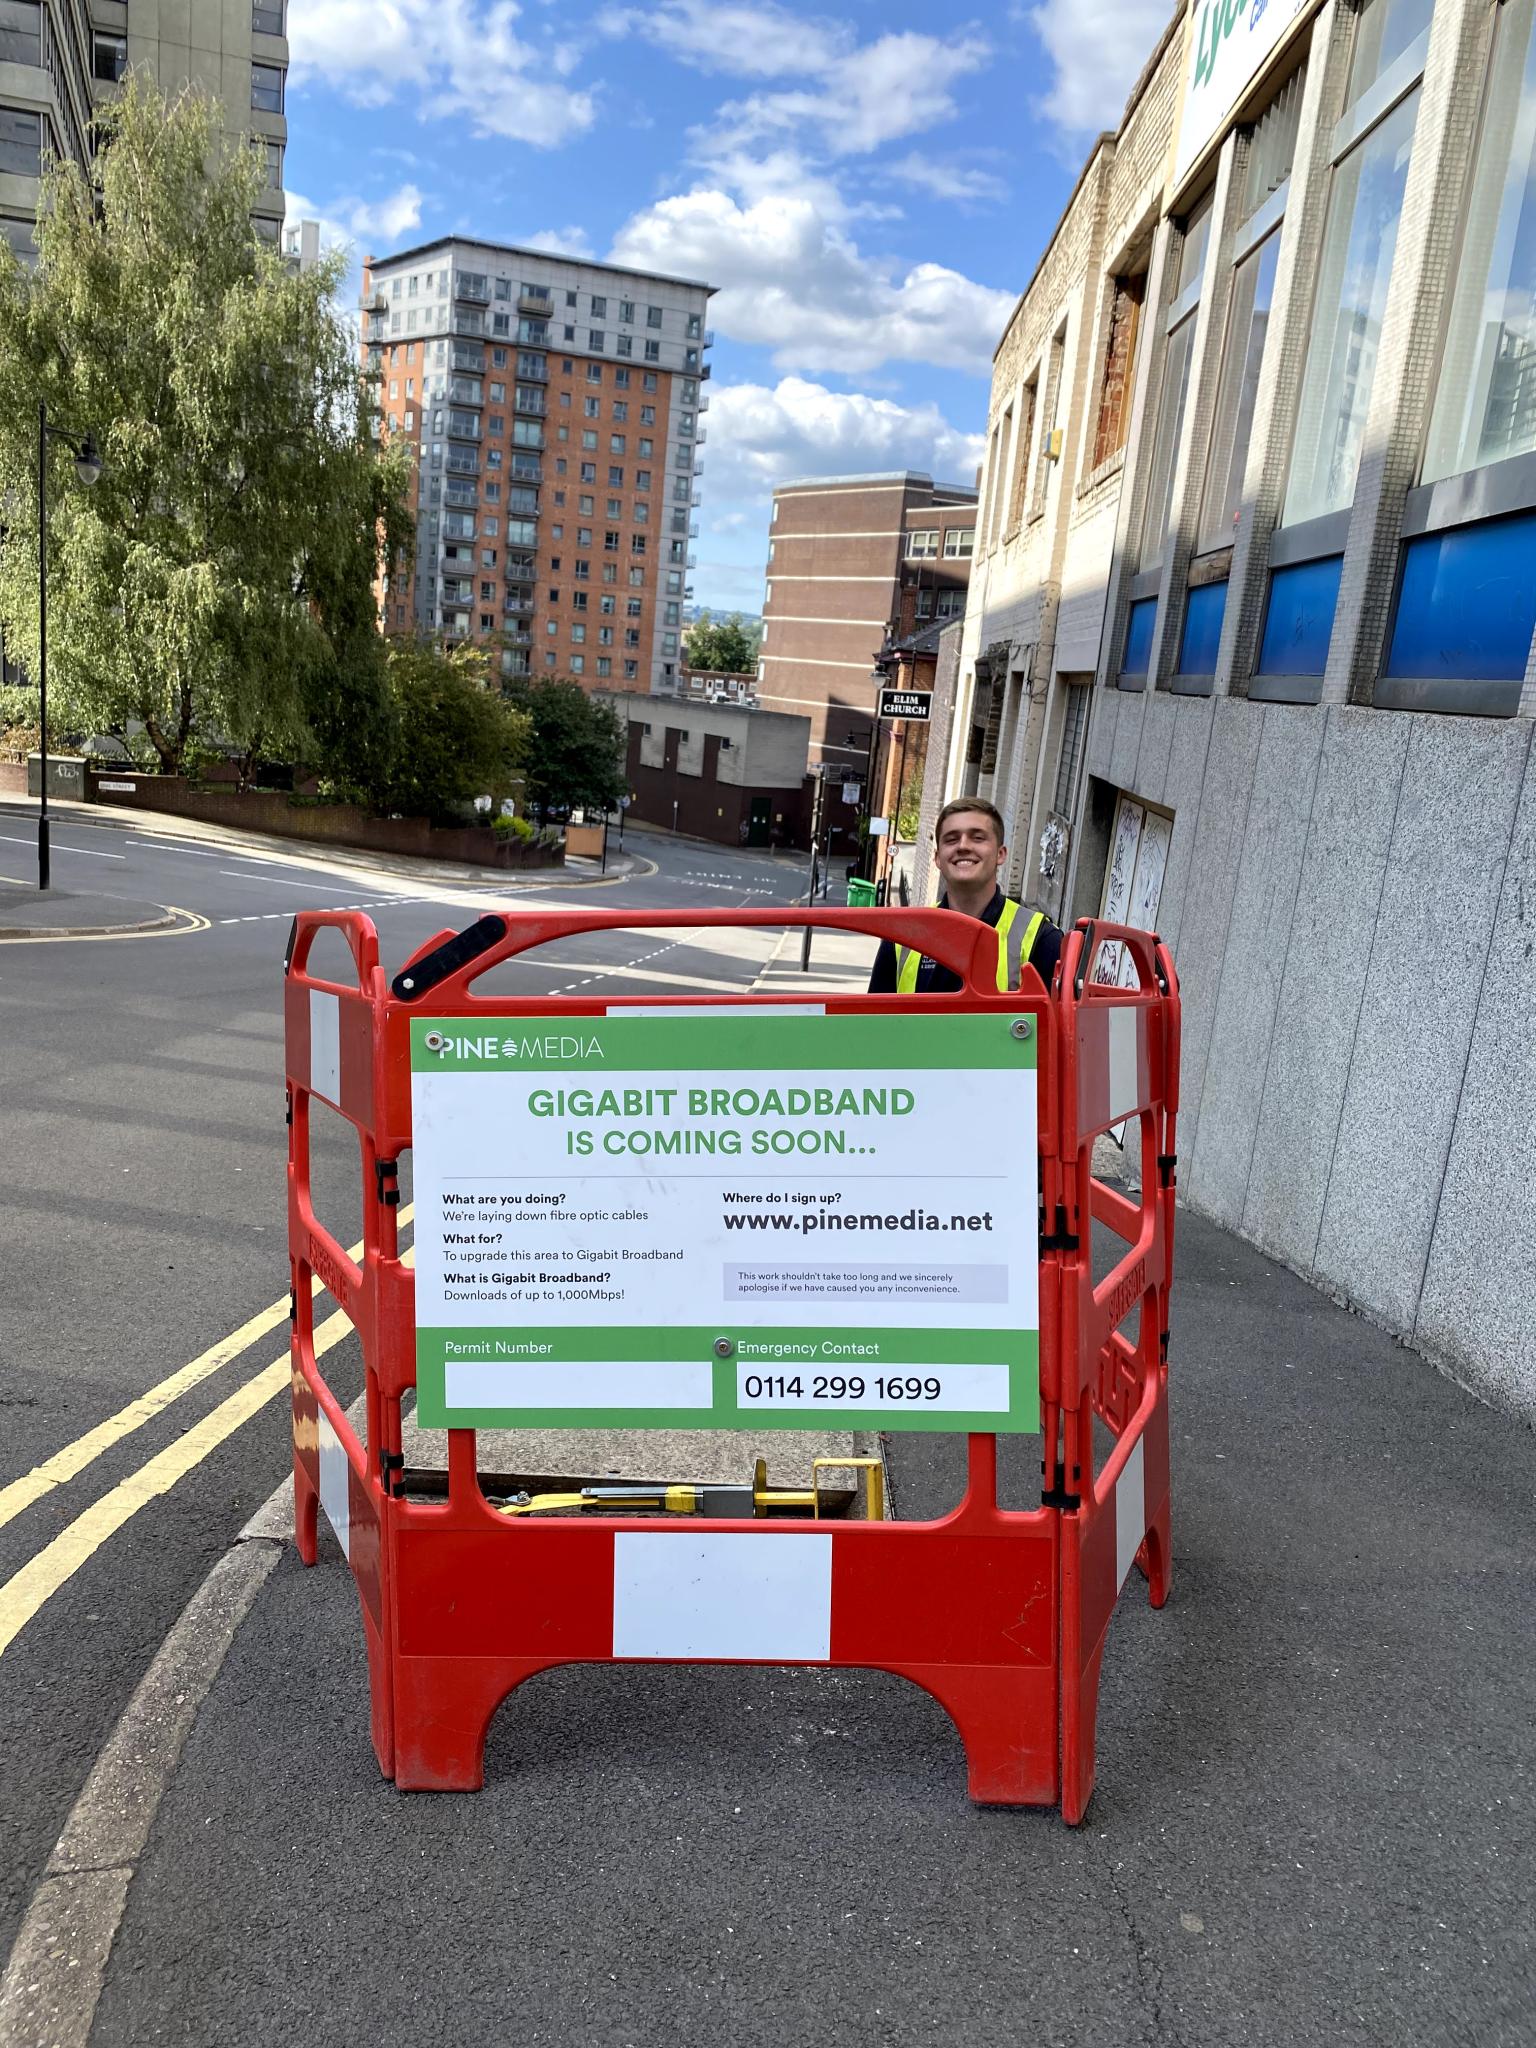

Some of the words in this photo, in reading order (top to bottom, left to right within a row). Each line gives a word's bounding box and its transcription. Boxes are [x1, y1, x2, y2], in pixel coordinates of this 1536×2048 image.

[893, 694, 919, 705] ELIM
[883, 703, 927, 715] CHURCH
[439, 1037, 498, 1059] PINE
[520, 1036, 604, 1058] MEDIA
[528, 1089, 677, 1117] GIGABIT
[689, 1088, 915, 1116] BROADBAND
[567, 1131, 594, 1155] IS
[603, 1130, 741, 1155] COMING
[751, 1130, 876, 1154] SOON...
[441, 1193, 476, 1205] What
[477, 1196, 498, 1205] are
[499, 1195, 523, 1207] you
[524, 1192, 567, 1207] doing?
[722, 1192, 764, 1204] Where
[765, 1192, 782, 1204] do
[791, 1191, 817, 1206] sign
[819, 1192, 842, 1206] up?
[442, 1210, 476, 1222] We're
[477, 1210, 513, 1224] laying
[514, 1210, 548, 1222] down
[549, 1209, 578, 1221] fibre
[579, 1209, 610, 1223] optic
[611, 1209, 649, 1221] cables
[723, 1208, 993, 1235] www.pinemedia.net
[442, 1233, 476, 1245] What
[477, 1232, 503, 1244] for?
[442, 1249, 458, 1262] To
[459, 1249, 508, 1264] upgrade
[509, 1249, 532, 1261] this
[533, 1251, 560, 1261] area
[561, 1250, 575, 1261] to
[575, 1248, 619, 1263] Gigabit
[621, 1248, 684, 1261] Broadband
[442, 1272, 477, 1284] What
[478, 1272, 489, 1284] is
[490, 1272, 537, 1286] Gigabit
[538, 1271, 612, 1284] Broadband?
[737, 1271, 757, 1281] This
[757, 1271, 780, 1281] work
[781, 1271, 821, 1281] shouldn't
[821, 1272, 842, 1281] take
[842, 1272, 859, 1281] too
[859, 1272, 880, 1283] long
[880, 1272, 898, 1282] and
[898, 1274, 913, 1282] we
[913, 1272, 954, 1284] sincerely
[443, 1289, 508, 1301] Downloads
[509, 1288, 523, 1301] of
[524, 1291, 541, 1303] up
[542, 1290, 555, 1301] to
[557, 1288, 625, 1303] 1,000Mbps!
[737, 1282, 780, 1294] apologise
[781, 1282, 788, 1292] if
[788, 1284, 803, 1293] we
[803, 1283, 826, 1293] have
[826, 1283, 858, 1293] caused
[858, 1285, 876, 1295] you
[876, 1285, 894, 1295] any
[894, 1283, 961, 1294] inconvenience.
[444, 1340, 492, 1355] Permit
[495, 1340, 554, 1355] Number
[738, 1341, 817, 1357] Emergency
[821, 1340, 880, 1356] Contact
[745, 1376, 804, 1398] 0114
[813, 1376, 865, 1399] 299
[874, 1377, 941, 1400] 1699
